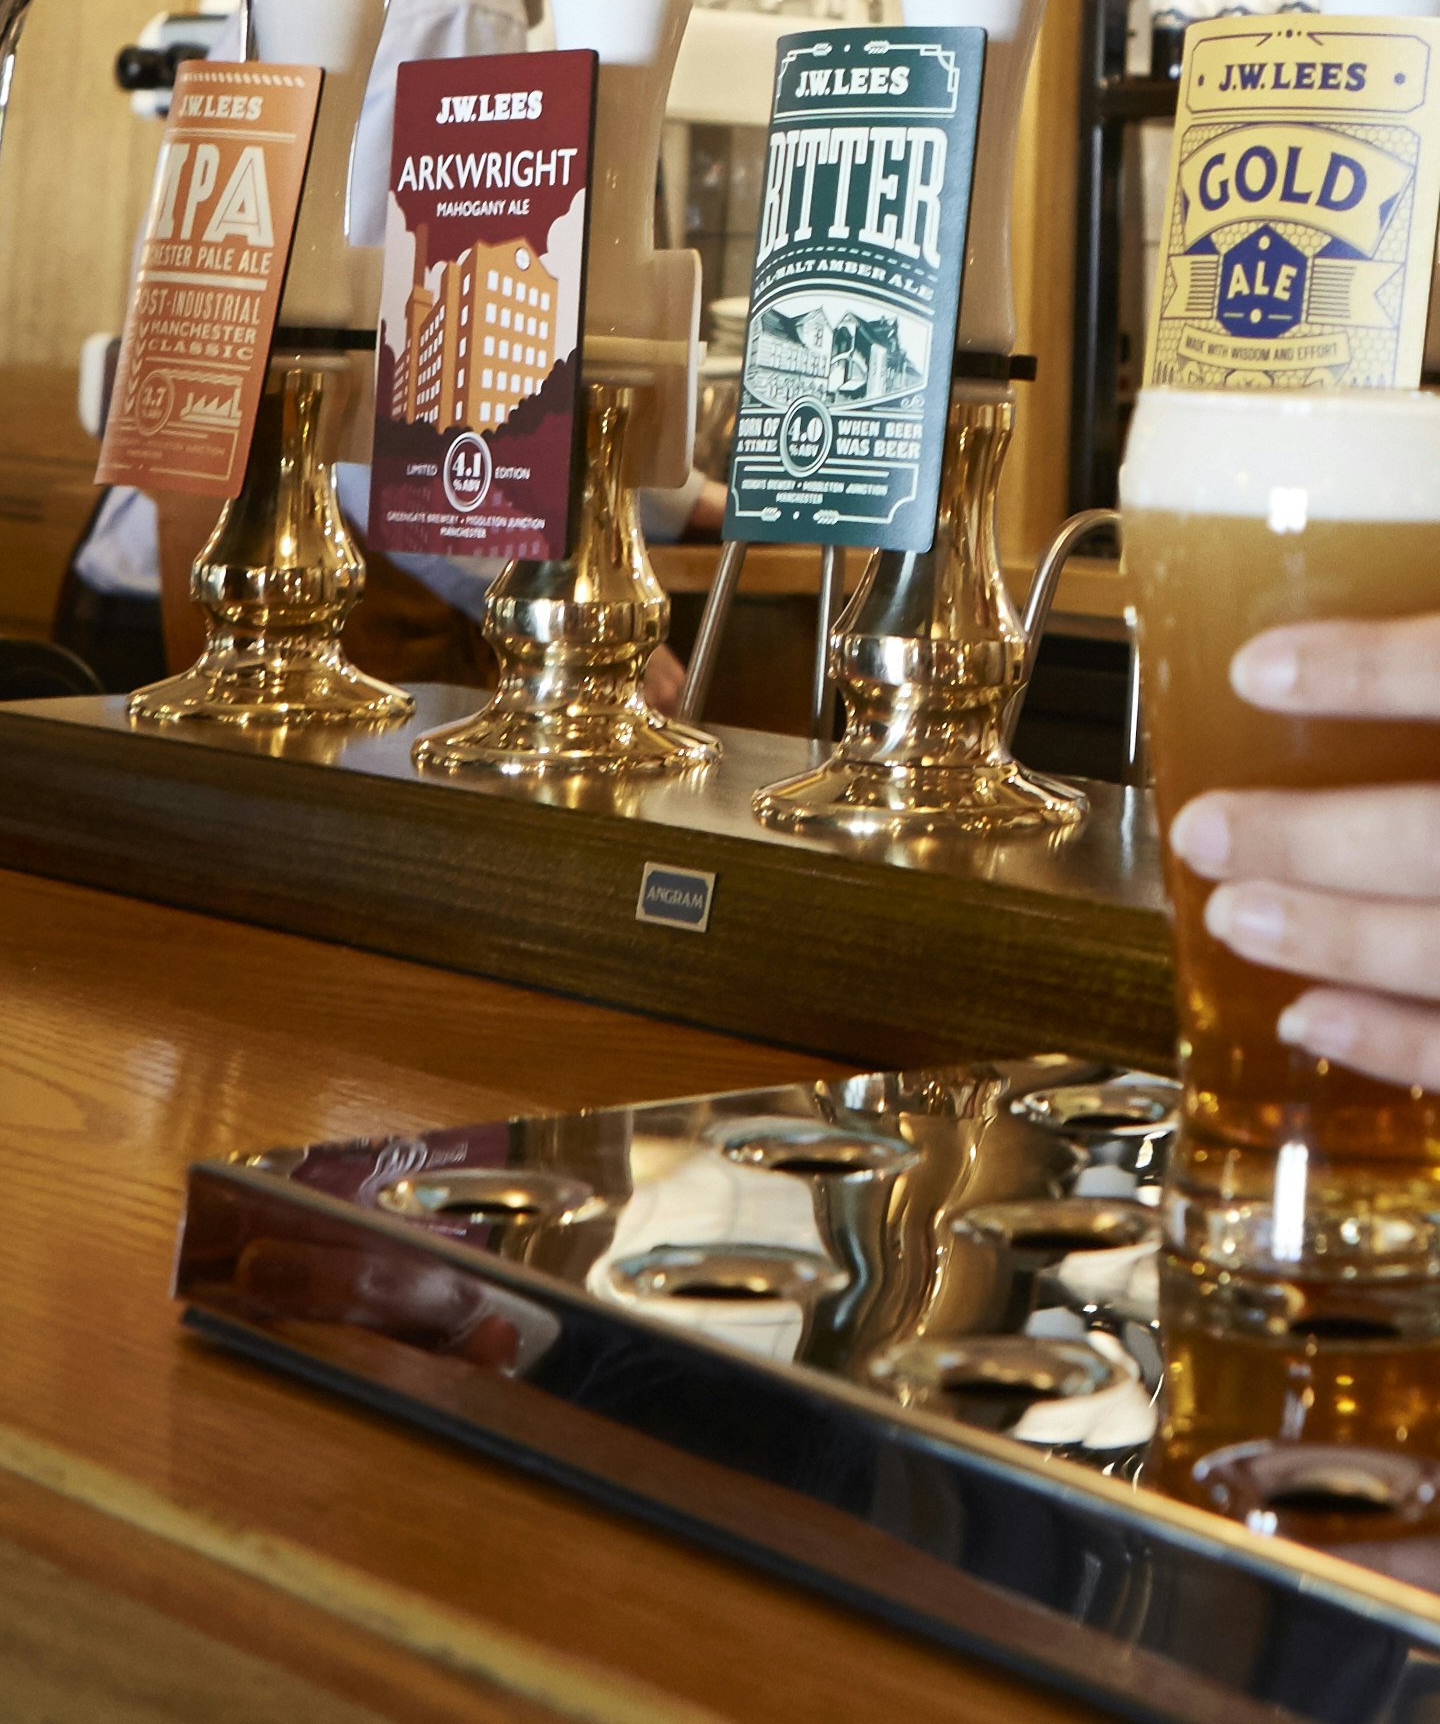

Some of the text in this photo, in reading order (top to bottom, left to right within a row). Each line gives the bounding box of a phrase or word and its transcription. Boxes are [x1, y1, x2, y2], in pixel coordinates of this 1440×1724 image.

[397, 148, 578, 192] ARKWRIGHT
[1199, 145, 1367, 212] GOLD
[436, 198, 530, 218] MAHOGANY ALE
[756, 127, 948, 269] BITTER
[196, 247, 233, 272] PALE
[238, 251, 275, 275] ALE
[816, 259, 887, 282] AMBER
[887, 273, 936, 302] ALE
[1227, 260, 1298, 302] ALE
[150, 321, 257, 345] MANCHESTER
[148, 339, 255, 361] CLASSIC
[1185, 336, 1337, 361] MADE WITH WISDOM AND EFFORT
[788, 416, 823, 442] 4.0
[838, 419, 924, 439] WHEN BEER
[836, 438, 921, 459] WAS BEER
[452, 452, 482, 477] 4.1
[495, 467, 531, 480] EDITION
[646, 886, 703, 909] ANGRAM
